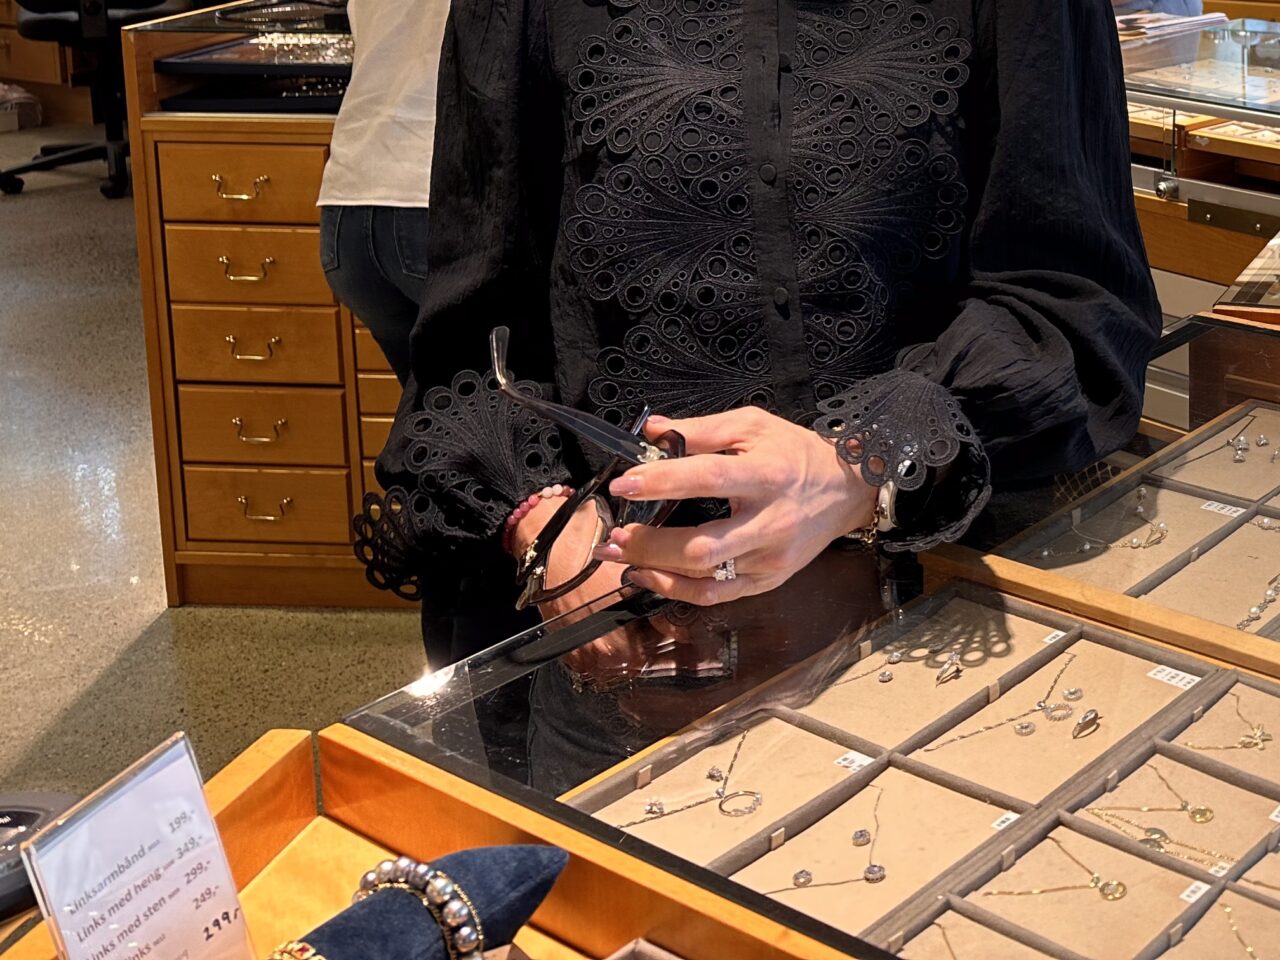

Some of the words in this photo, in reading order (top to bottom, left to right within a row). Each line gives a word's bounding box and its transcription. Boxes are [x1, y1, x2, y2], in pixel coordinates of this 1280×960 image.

[77, 913, 106, 943] Links
[107, 888, 133, 917] med
[133, 867, 163, 896] heng
[176, 835, 203, 860] 349,-
[116, 915, 142, 944] med
[143, 896, 167, 921] sten
[184, 859, 211, 885] 299,-
[192, 884, 220, 910] 249,-
